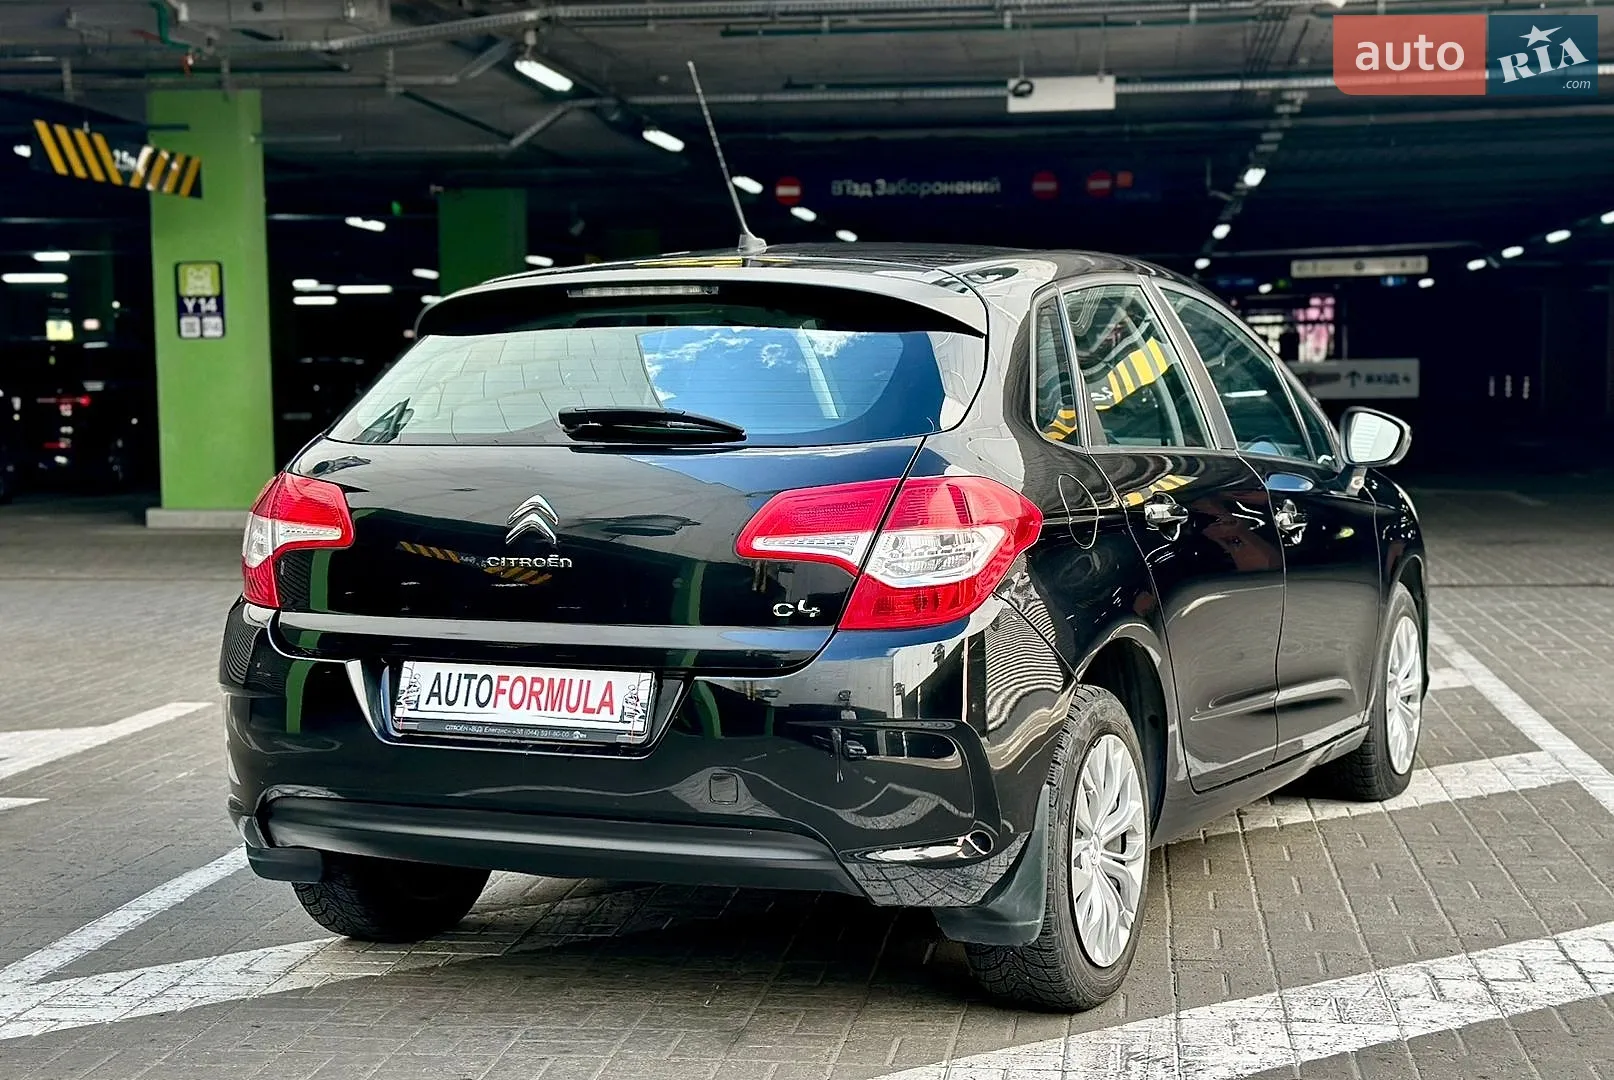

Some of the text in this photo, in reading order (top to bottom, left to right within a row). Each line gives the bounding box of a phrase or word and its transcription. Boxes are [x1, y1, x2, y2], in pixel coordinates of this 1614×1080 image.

[874, 176, 1002, 200] Заборонений
[772, 599, 820, 618] C4
[425, 671, 614, 716] AUTOFORMULA
